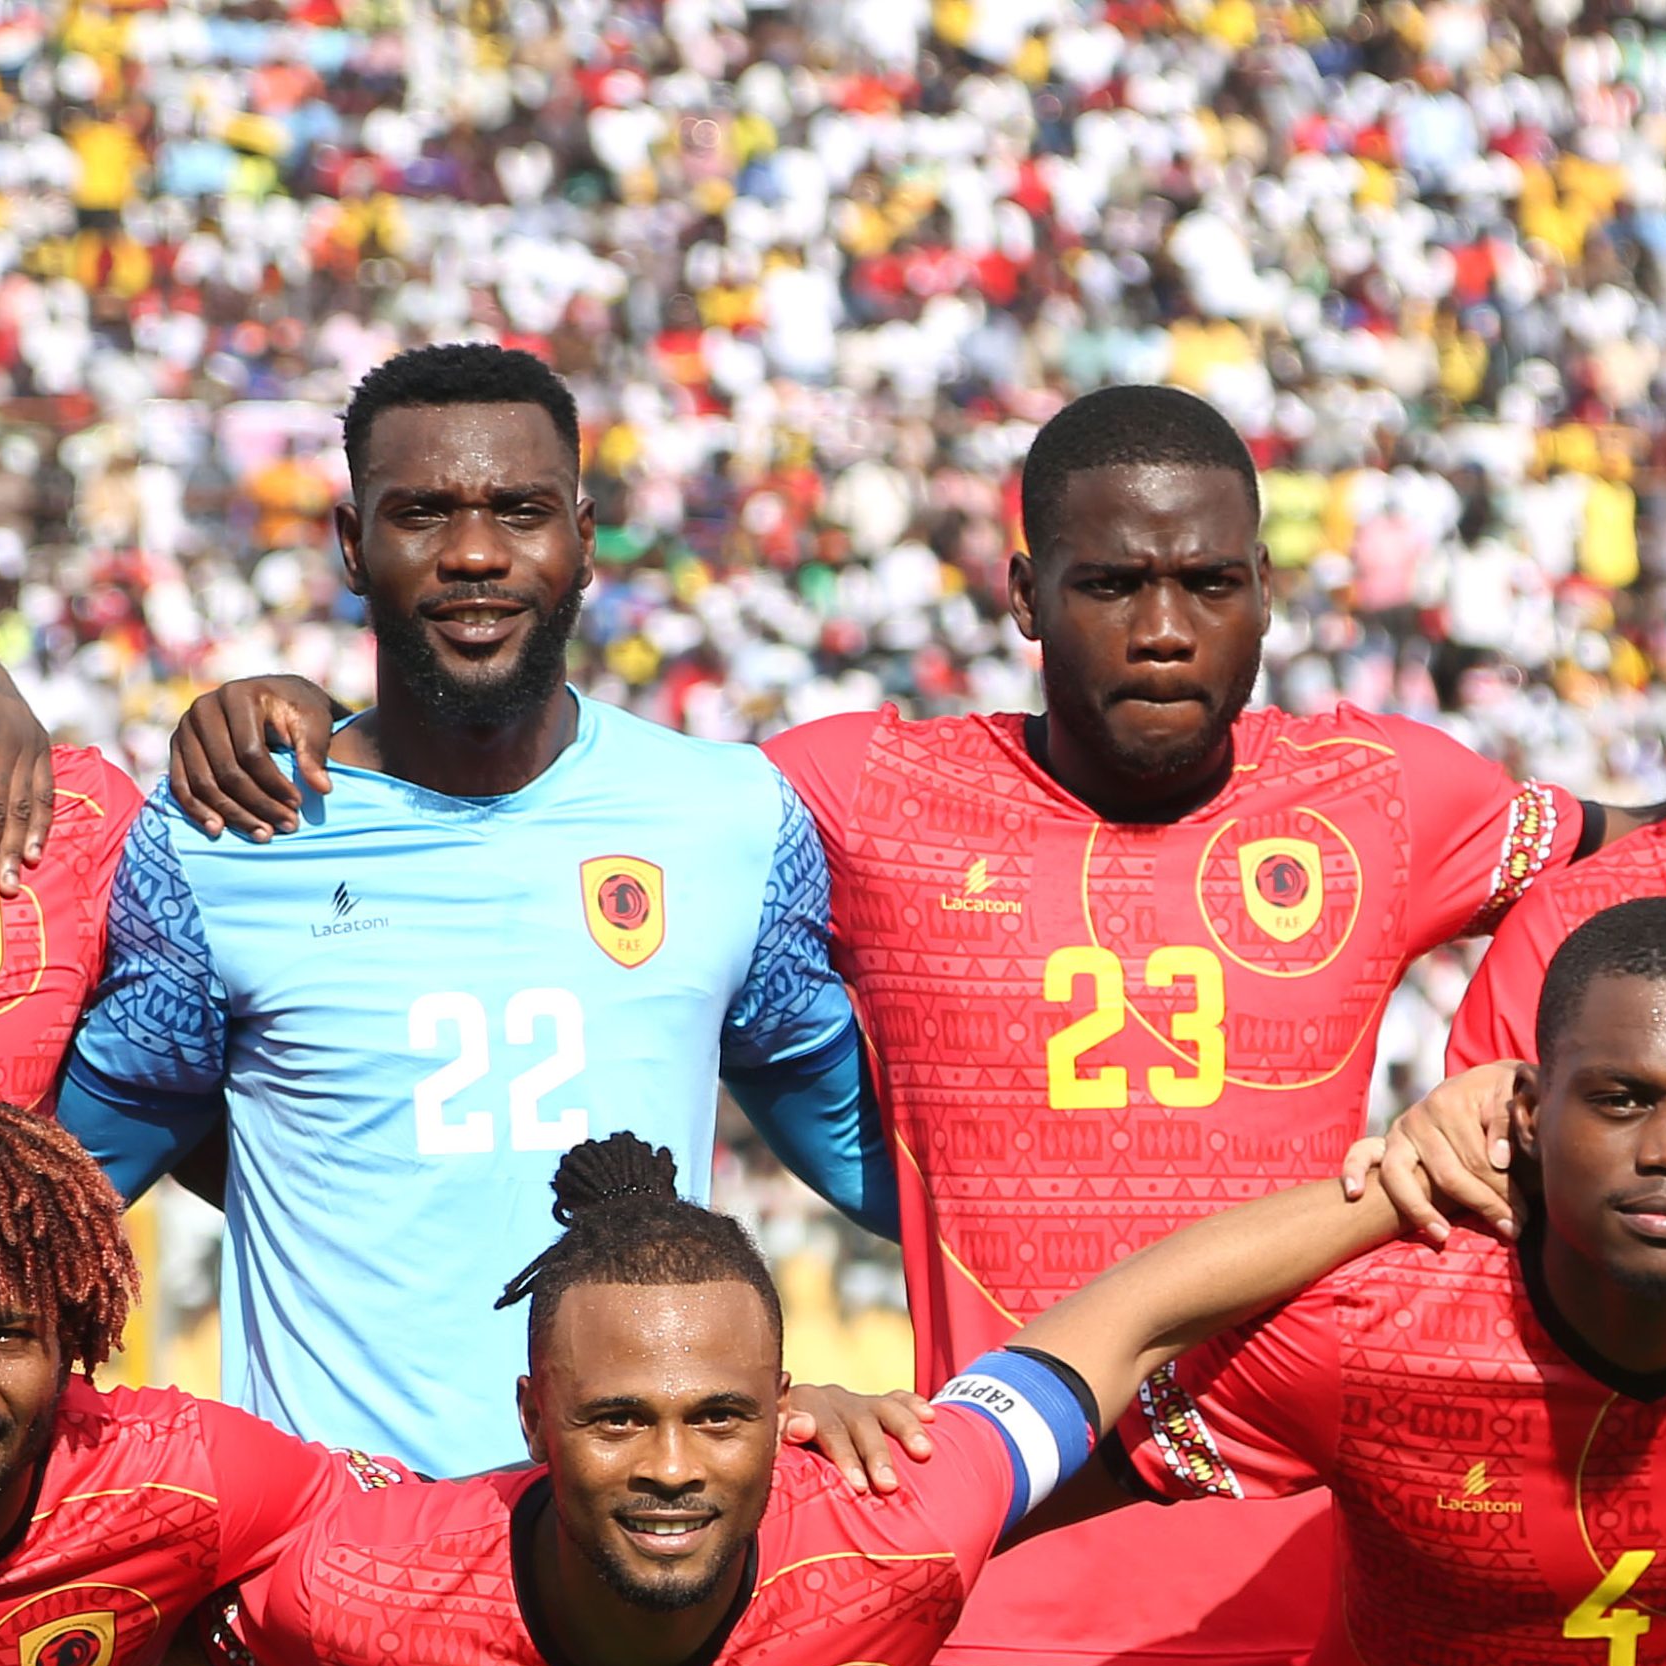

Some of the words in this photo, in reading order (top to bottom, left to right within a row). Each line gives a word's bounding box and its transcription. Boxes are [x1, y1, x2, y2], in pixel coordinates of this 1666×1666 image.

[940, 892, 1023, 915] Lacatoni
[311, 916, 390, 938] Lacatoni
[1044, 945, 1227, 1110] 23
[407, 988, 589, 1156] 22
[1436, 1493, 1523, 1514] Lacatoni
